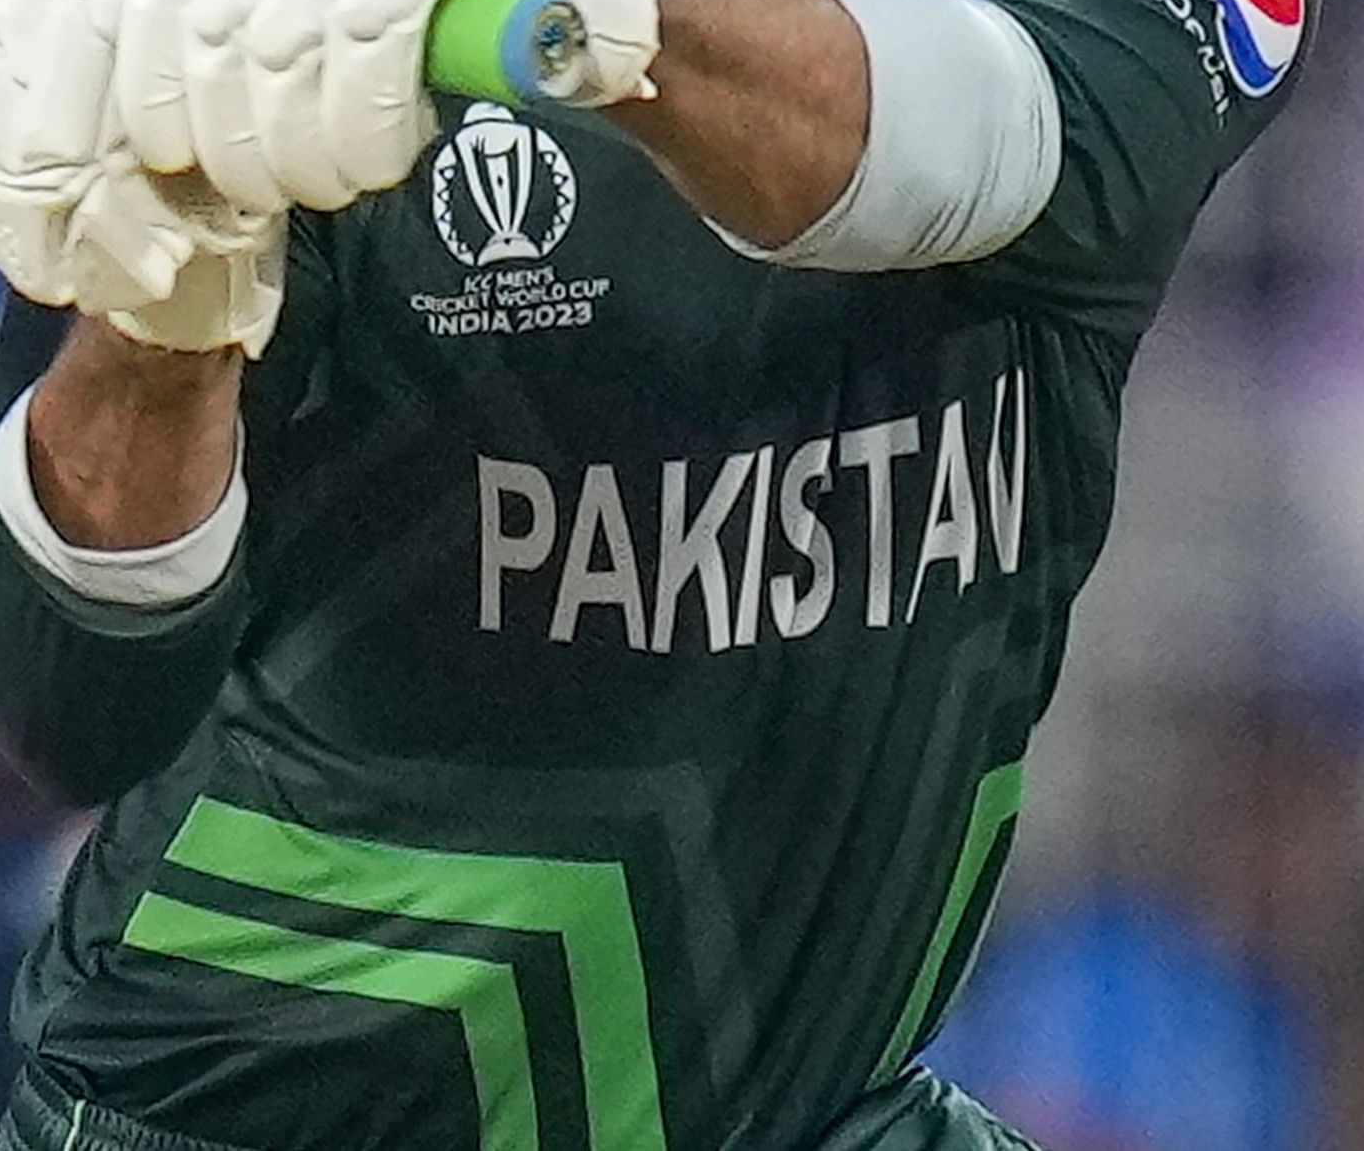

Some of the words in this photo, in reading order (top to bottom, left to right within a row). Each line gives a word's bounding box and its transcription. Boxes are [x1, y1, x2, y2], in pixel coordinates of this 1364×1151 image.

[410, 292, 489, 313] CRICKET
[495, 283, 566, 306] WORLD
[570, 278, 611, 298] CUP
[428, 310, 513, 335] INDIA
[517, 301, 593, 332] 2023
[476, 365, 1026, 654] PAKISTAN
